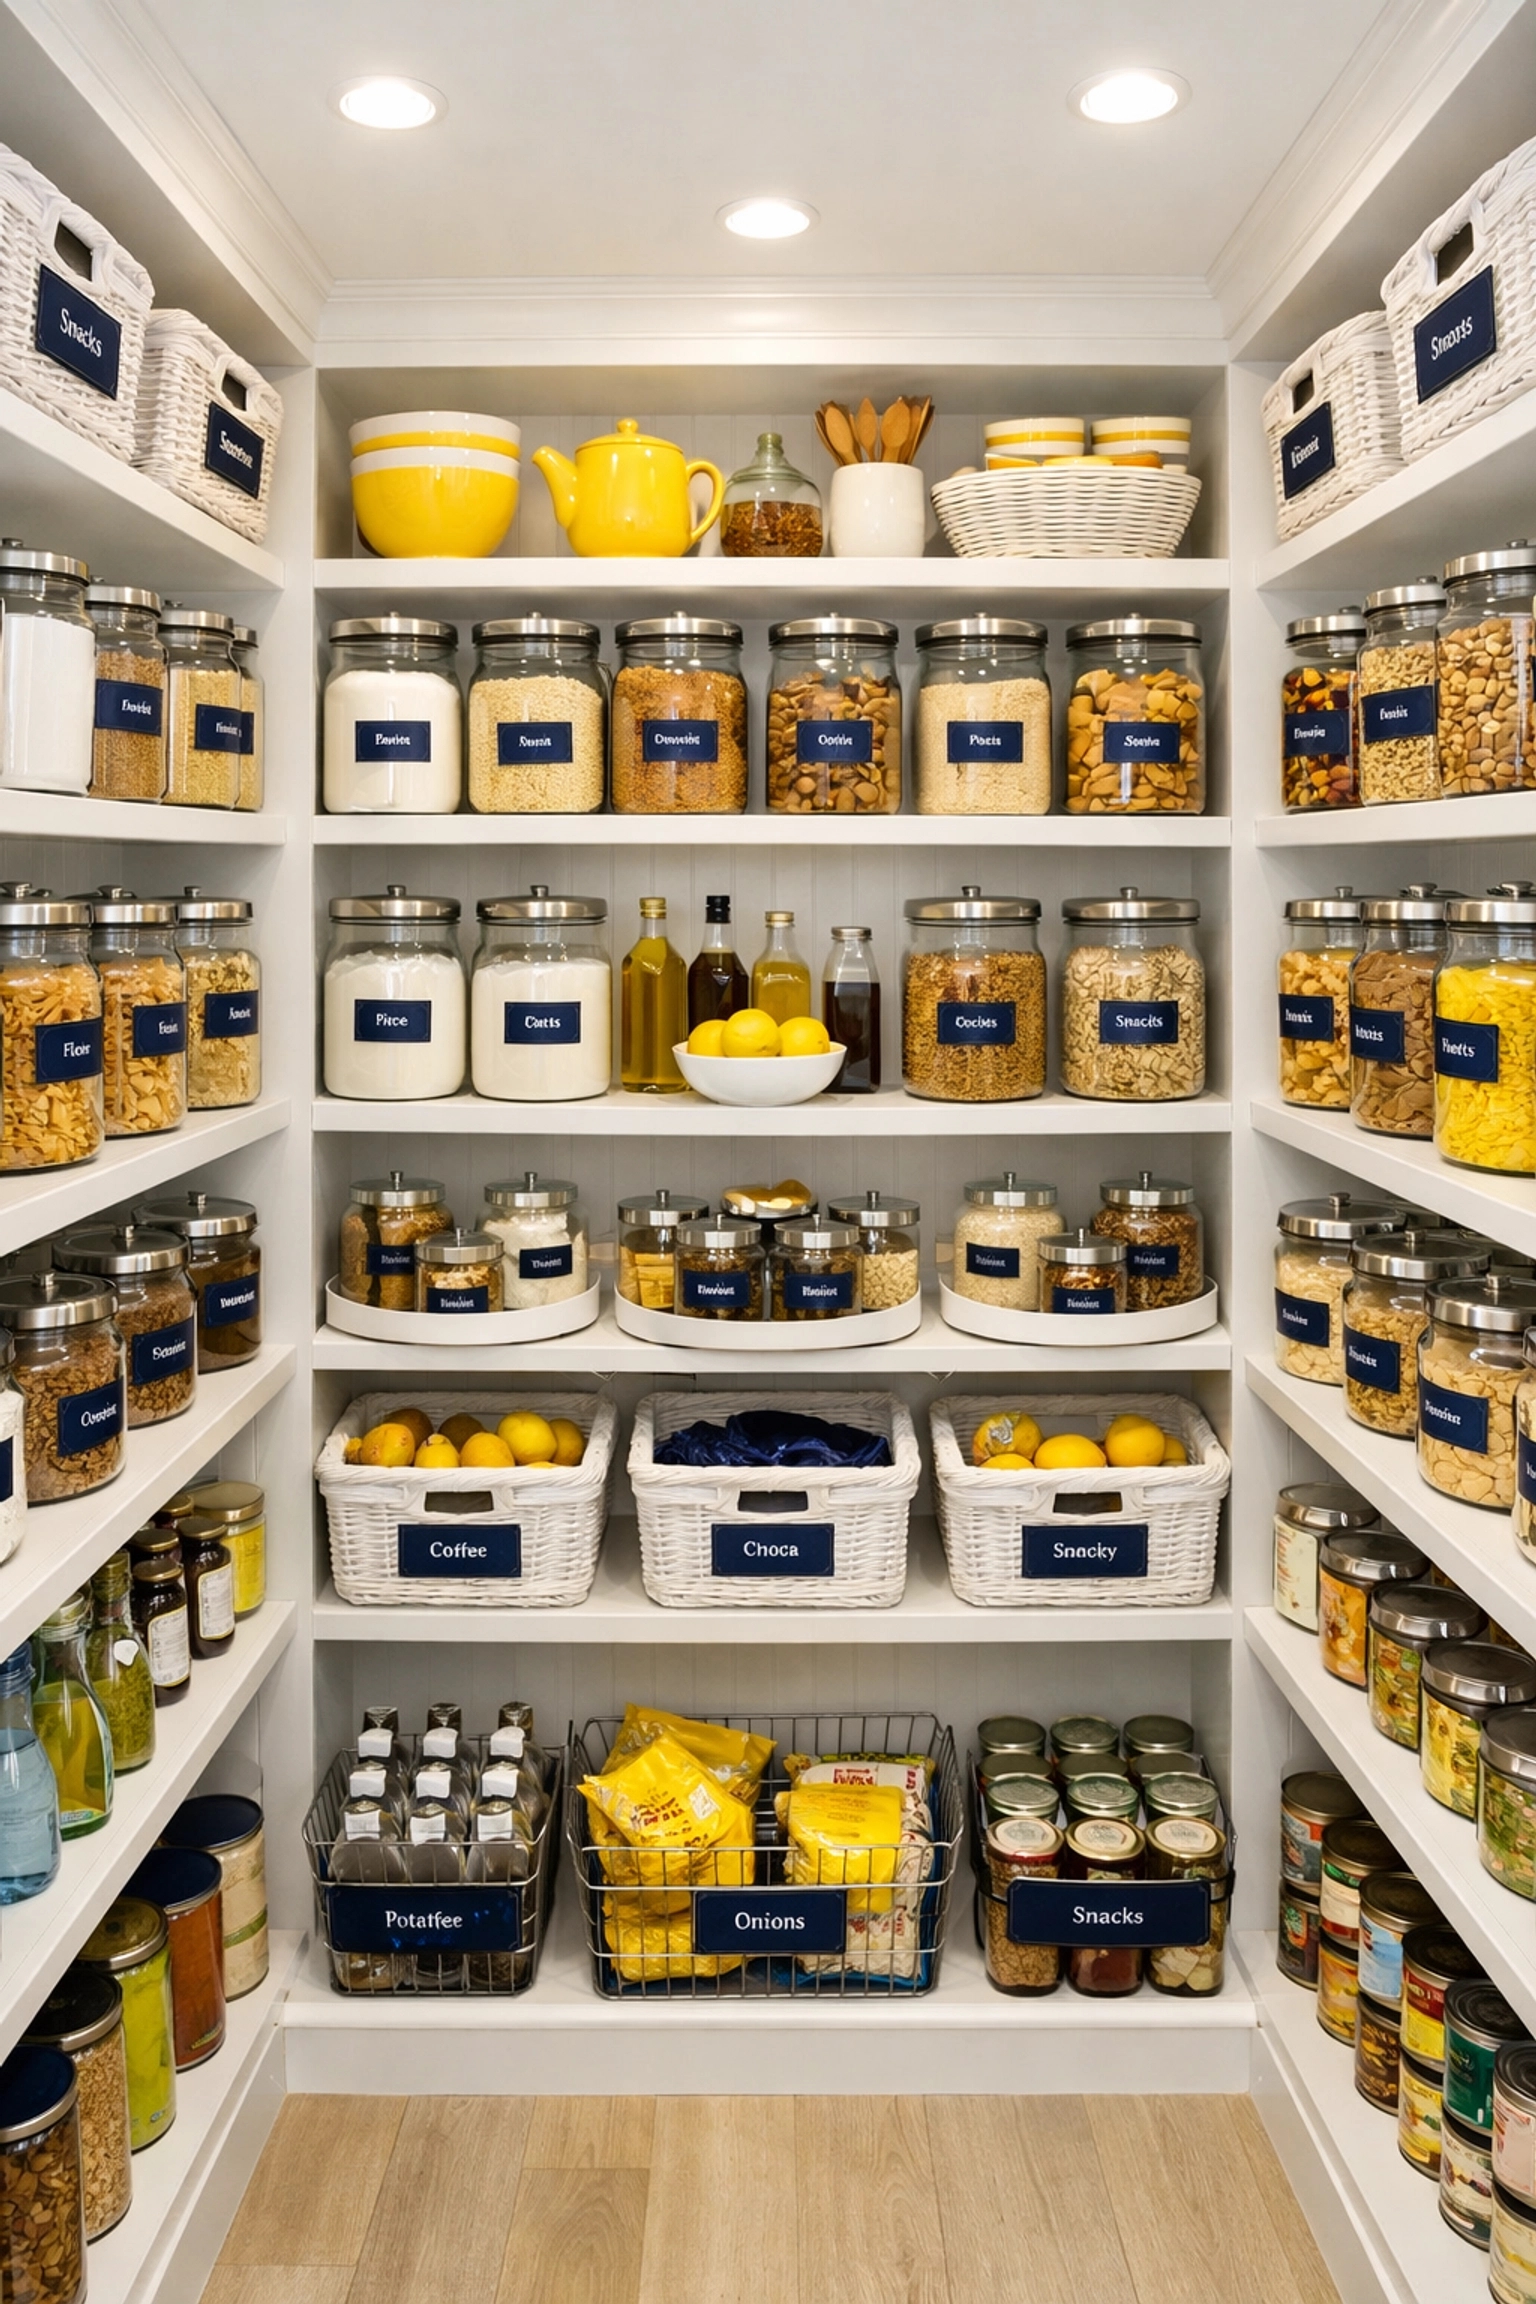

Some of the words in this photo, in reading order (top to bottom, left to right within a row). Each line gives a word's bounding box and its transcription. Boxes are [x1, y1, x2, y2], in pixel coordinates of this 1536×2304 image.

[429, 1541, 487, 1558] Coffee
[743, 1540, 799, 1557] Choca
[734, 1911, 805, 1930] Onions
[1072, 1906, 1144, 1925] Snacks
